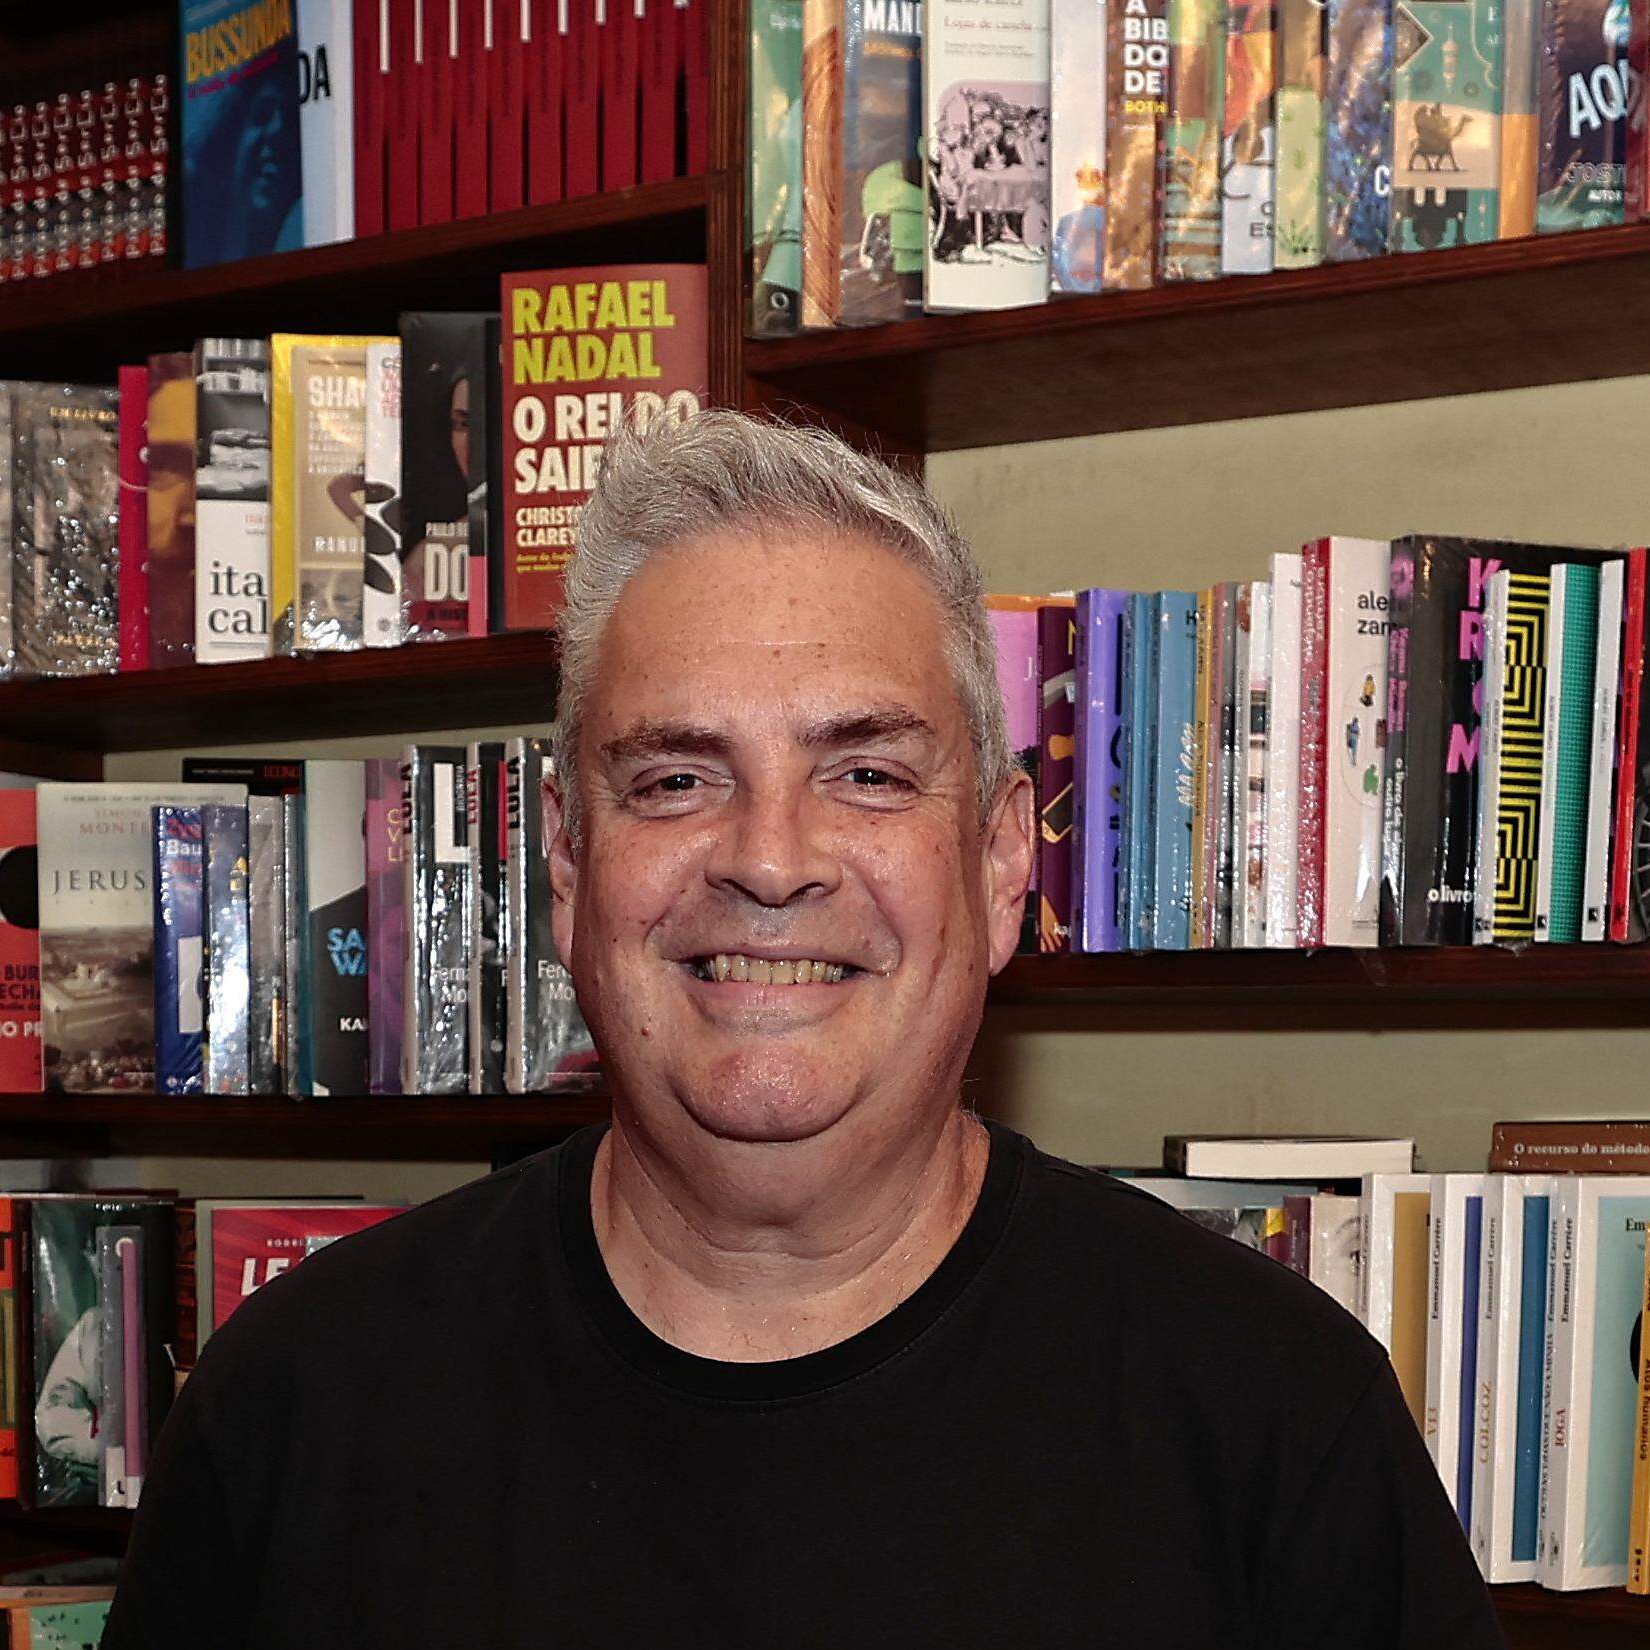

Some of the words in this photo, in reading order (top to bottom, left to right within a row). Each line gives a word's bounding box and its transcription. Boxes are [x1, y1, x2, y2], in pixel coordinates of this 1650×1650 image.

[512, 279, 676, 335] RAFAEL
[512, 333, 660, 384] NADAL
[512, 397, 545, 442] O
[553, 392, 617, 441] REI
